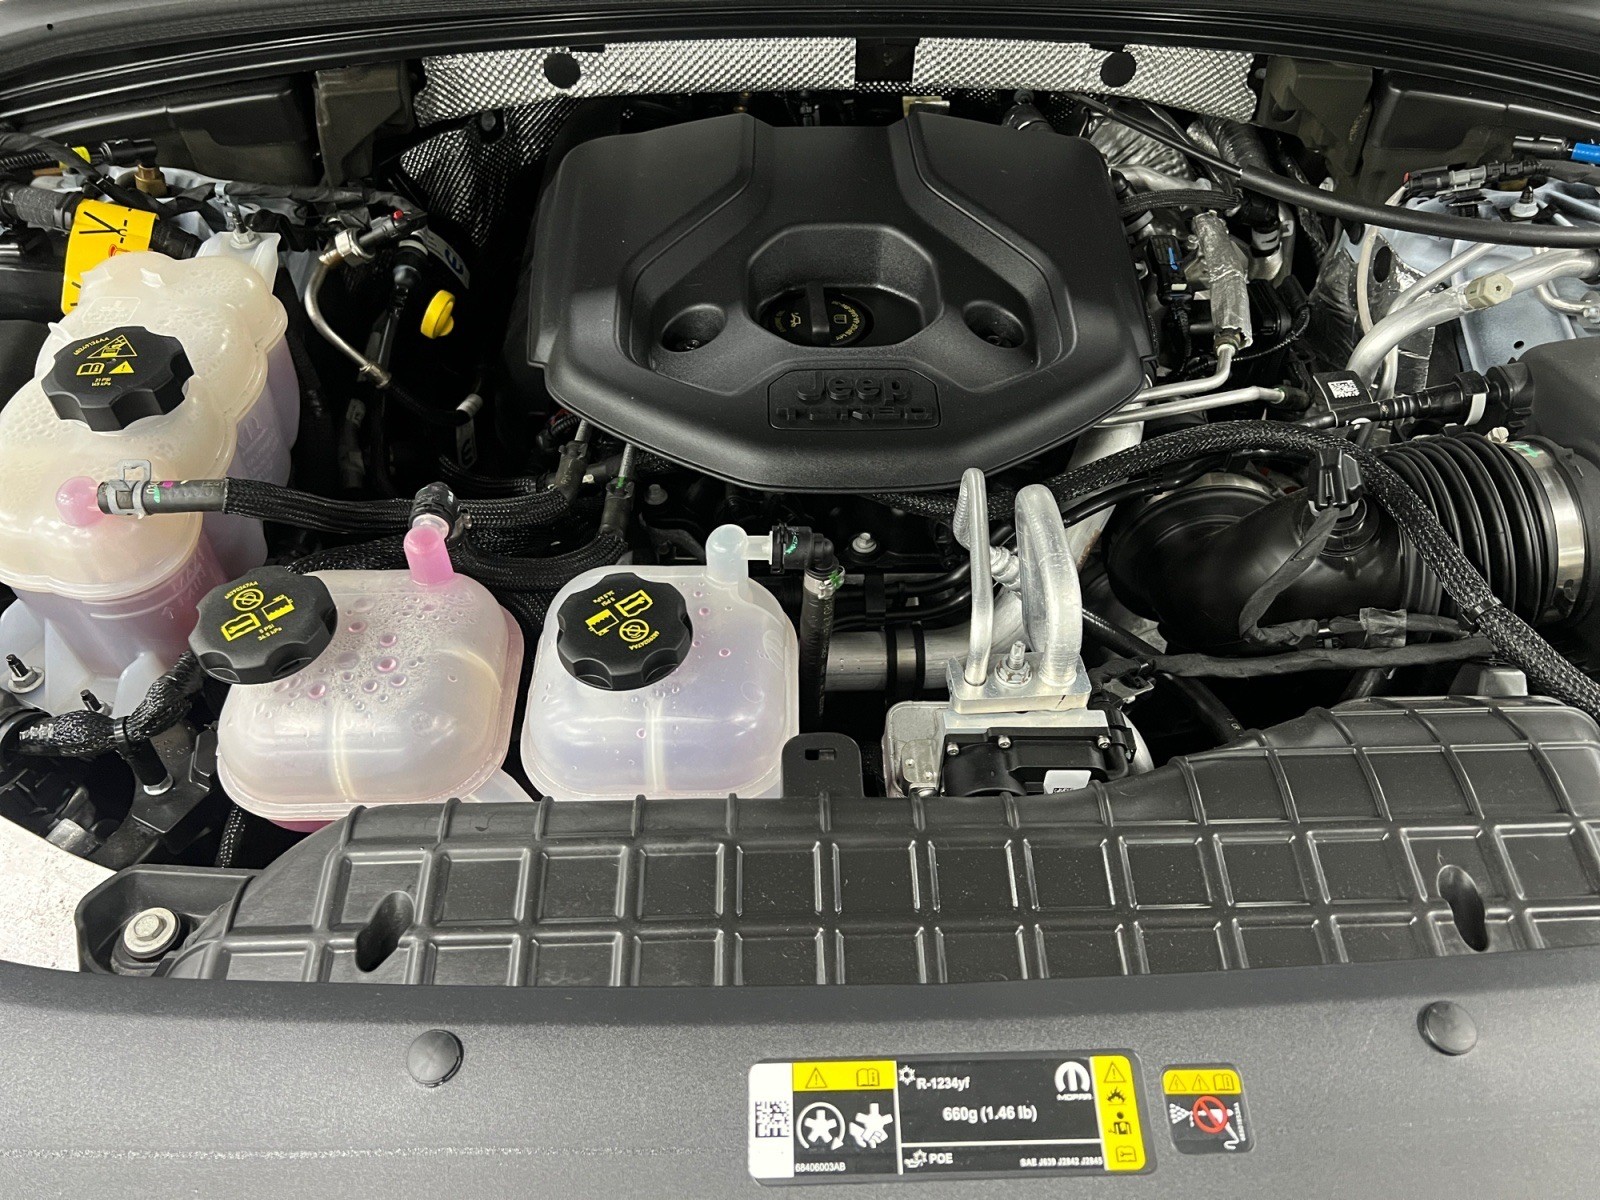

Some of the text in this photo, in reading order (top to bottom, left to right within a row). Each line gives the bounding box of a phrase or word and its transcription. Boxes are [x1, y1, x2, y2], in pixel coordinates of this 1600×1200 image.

[795, 371, 913, 406] Jeep
[263, 623, 275, 632] PSI
[916, 1076, 971, 1092] R-1234yf
[942, 1104, 1038, 1124] 660g (1.46 lb)
[928, 1152, 954, 1165] POE
[795, 1161, 847, 1174] 68406003AB
